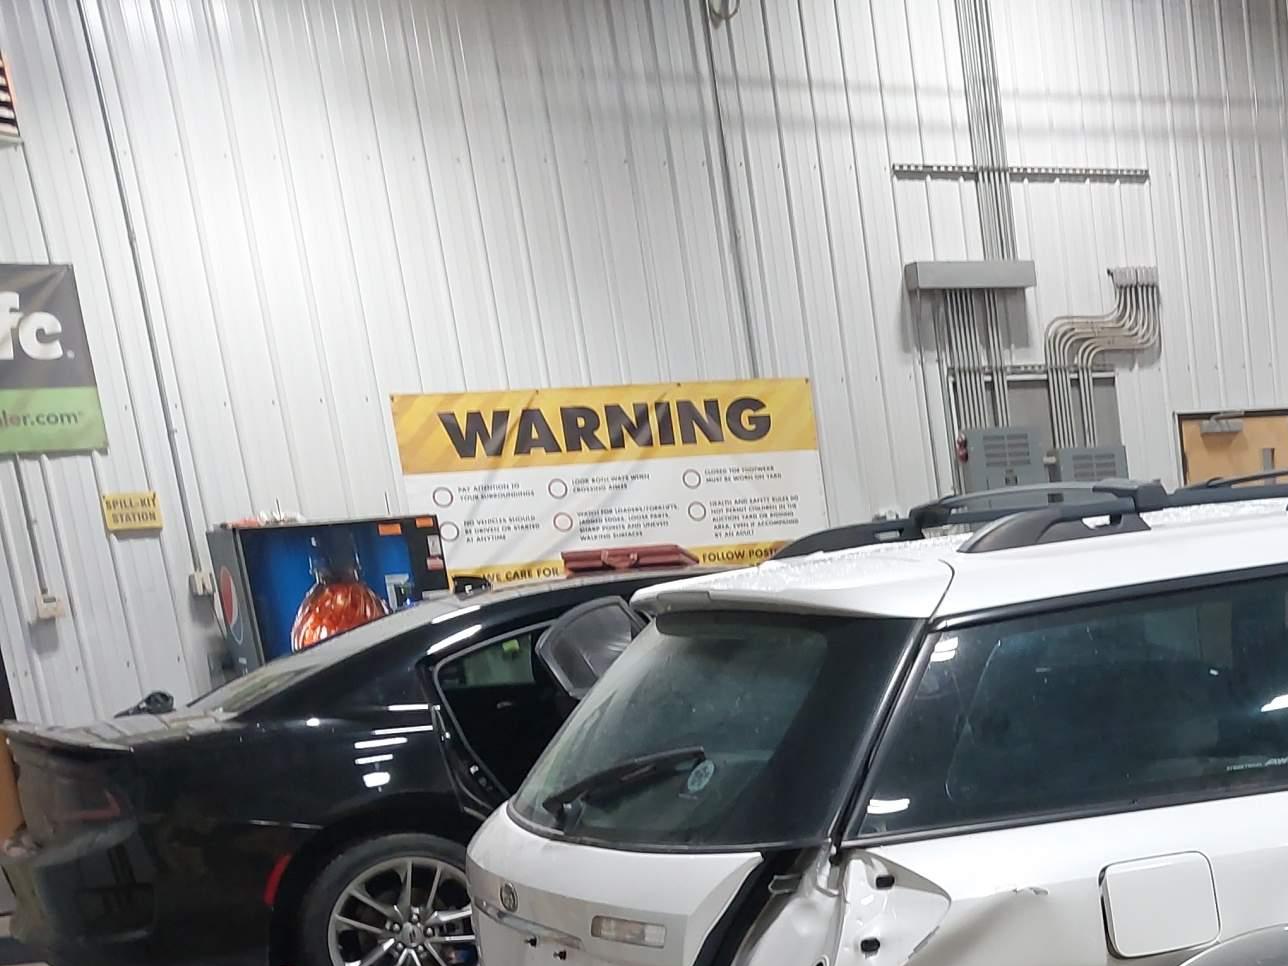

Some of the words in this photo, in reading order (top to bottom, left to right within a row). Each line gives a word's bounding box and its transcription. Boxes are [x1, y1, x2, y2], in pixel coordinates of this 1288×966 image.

[0, 410, 79, 427] ler.com
[438, 397, 771, 458] WARNING
[112, 511, 156, 523] STATION
[702, 549, 746, 563] FOLLOW
[505, 569, 532, 582] CARE
[537, 567, 559, 578] FOR
